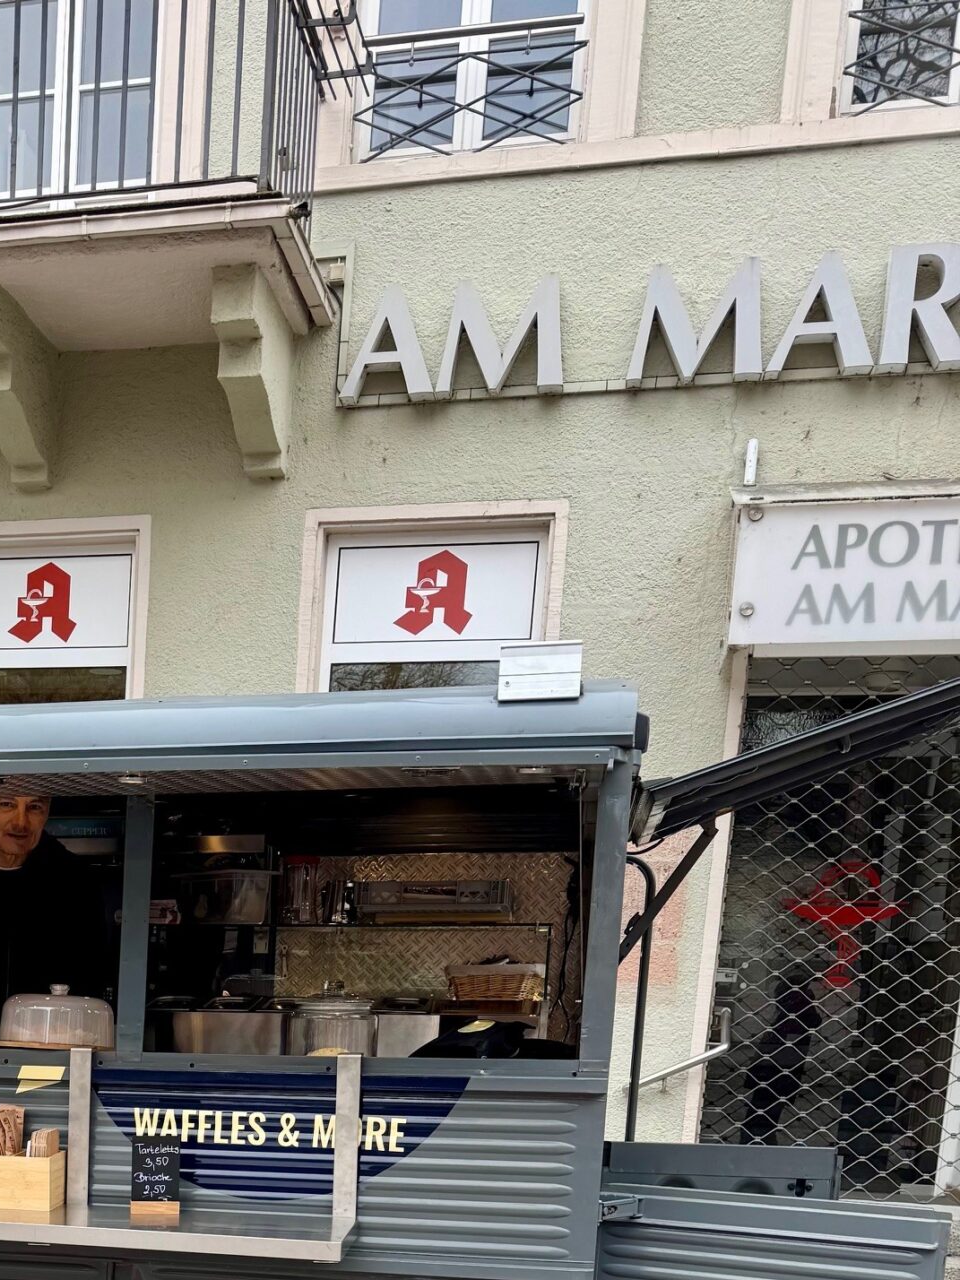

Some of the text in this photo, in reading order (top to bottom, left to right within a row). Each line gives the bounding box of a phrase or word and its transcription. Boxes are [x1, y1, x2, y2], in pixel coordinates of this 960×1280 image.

[339, 244, 960, 403] AM MAR
[791, 518, 960, 571] APOT
[785, 580, 960, 626] AM M
[134, 1107, 407, 1153] WAFFLES & MRE
[134, 1171, 173, 1182] Brioche
[142, 1156, 169, 1171] 3,50
